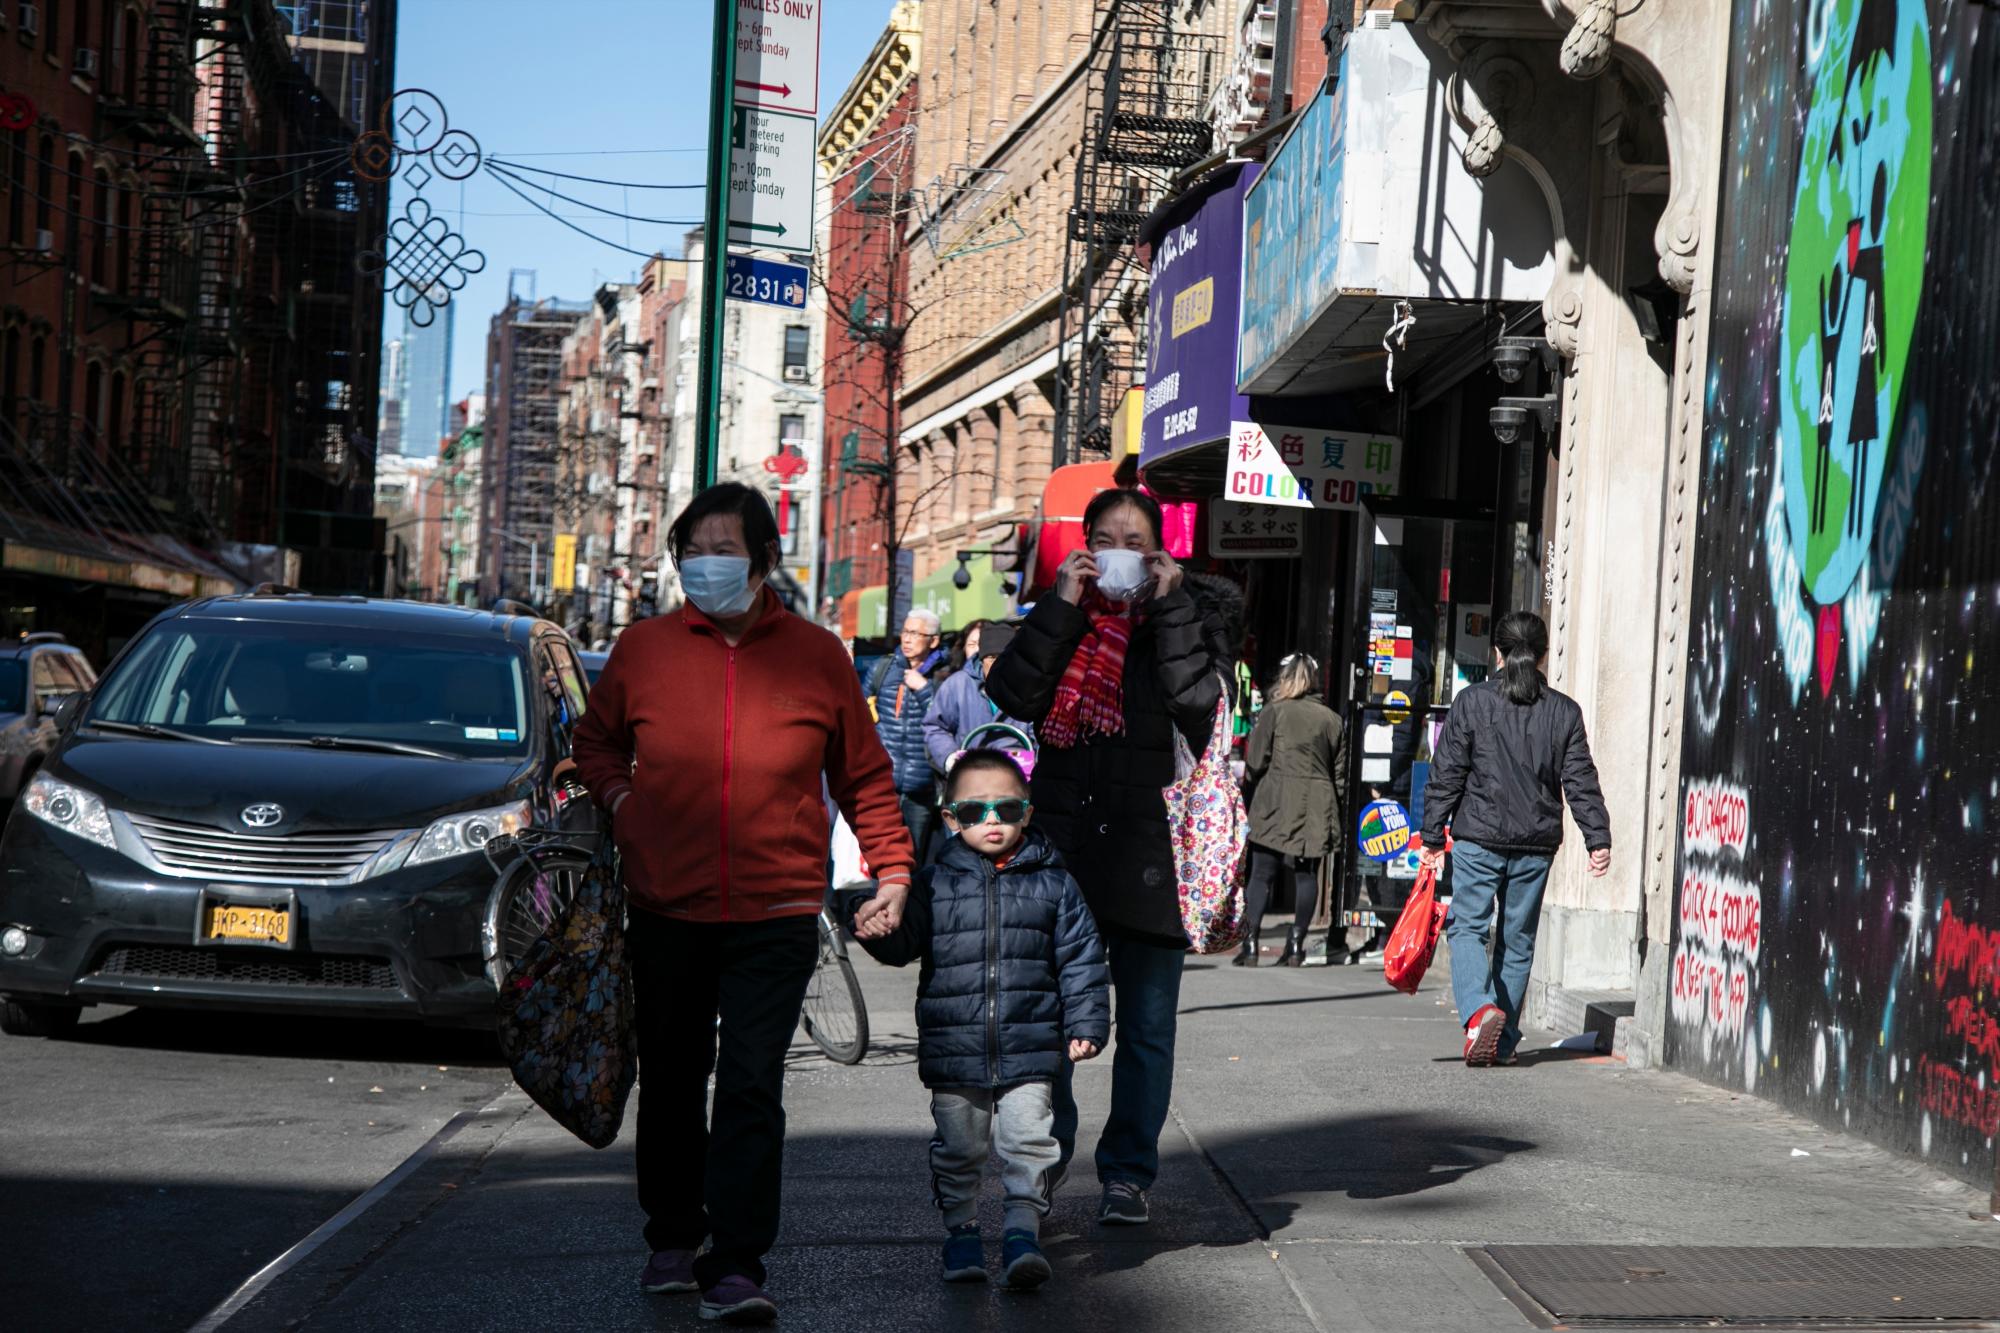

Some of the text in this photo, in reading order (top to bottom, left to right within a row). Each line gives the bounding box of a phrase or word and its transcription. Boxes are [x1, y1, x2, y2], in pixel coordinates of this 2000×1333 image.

[784, 1, 813, 20] ONLY
[752, 22, 772, 37] 6pm
[738, 38, 790, 60] ept Sunday
[750, 115, 769, 127] hour
[750, 130, 784, 143] metered
[750, 142, 780, 157] parking
[747, 162, 771, 177] 10pm
[751, 181, 785, 199] Sunday
[726, 273, 779, 301] 2831
[1237, 430, 1393, 475] 彩色复印
[1232, 471, 1393, 506] COLOR COPY
[1379, 804, 1400, 817] NEW
[1382, 813, 1407, 832] YORK
[1362, 826, 1410, 857] LOTTERY
[1709, 885, 1718, 945] 4
[1675, 953, 1745, 1034] OR GET THE APP
